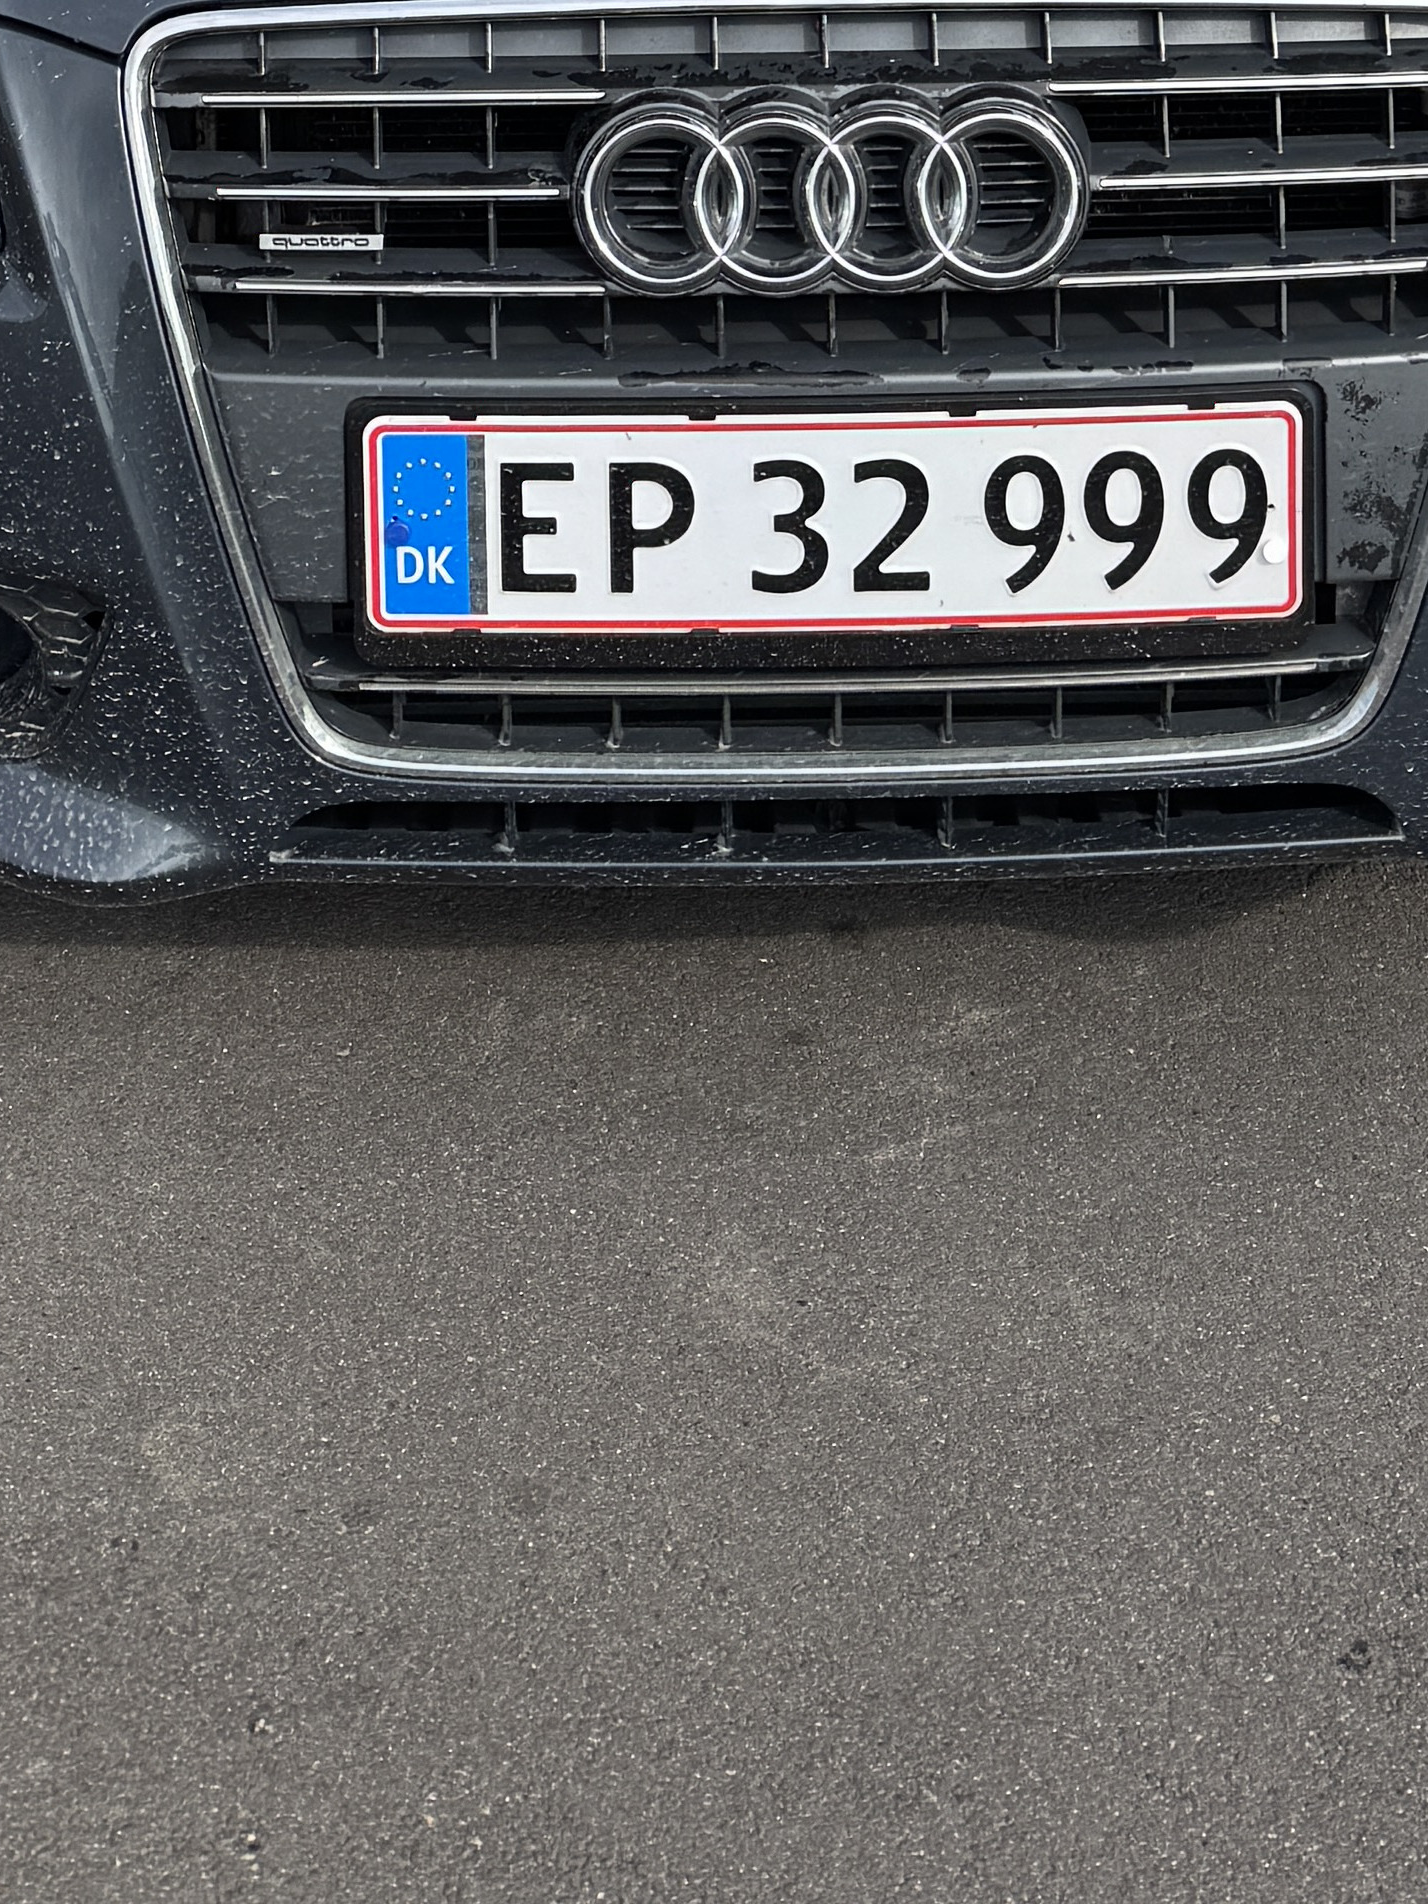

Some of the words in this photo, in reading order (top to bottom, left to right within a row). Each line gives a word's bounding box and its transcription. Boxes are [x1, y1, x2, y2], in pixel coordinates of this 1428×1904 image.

[272, 236, 370, 250] quattro
[499, 461, 697, 594] EP
[750, 458, 932, 594] 32
[982, 448, 1270, 595] 999
[395, 545, 456, 585] DK
